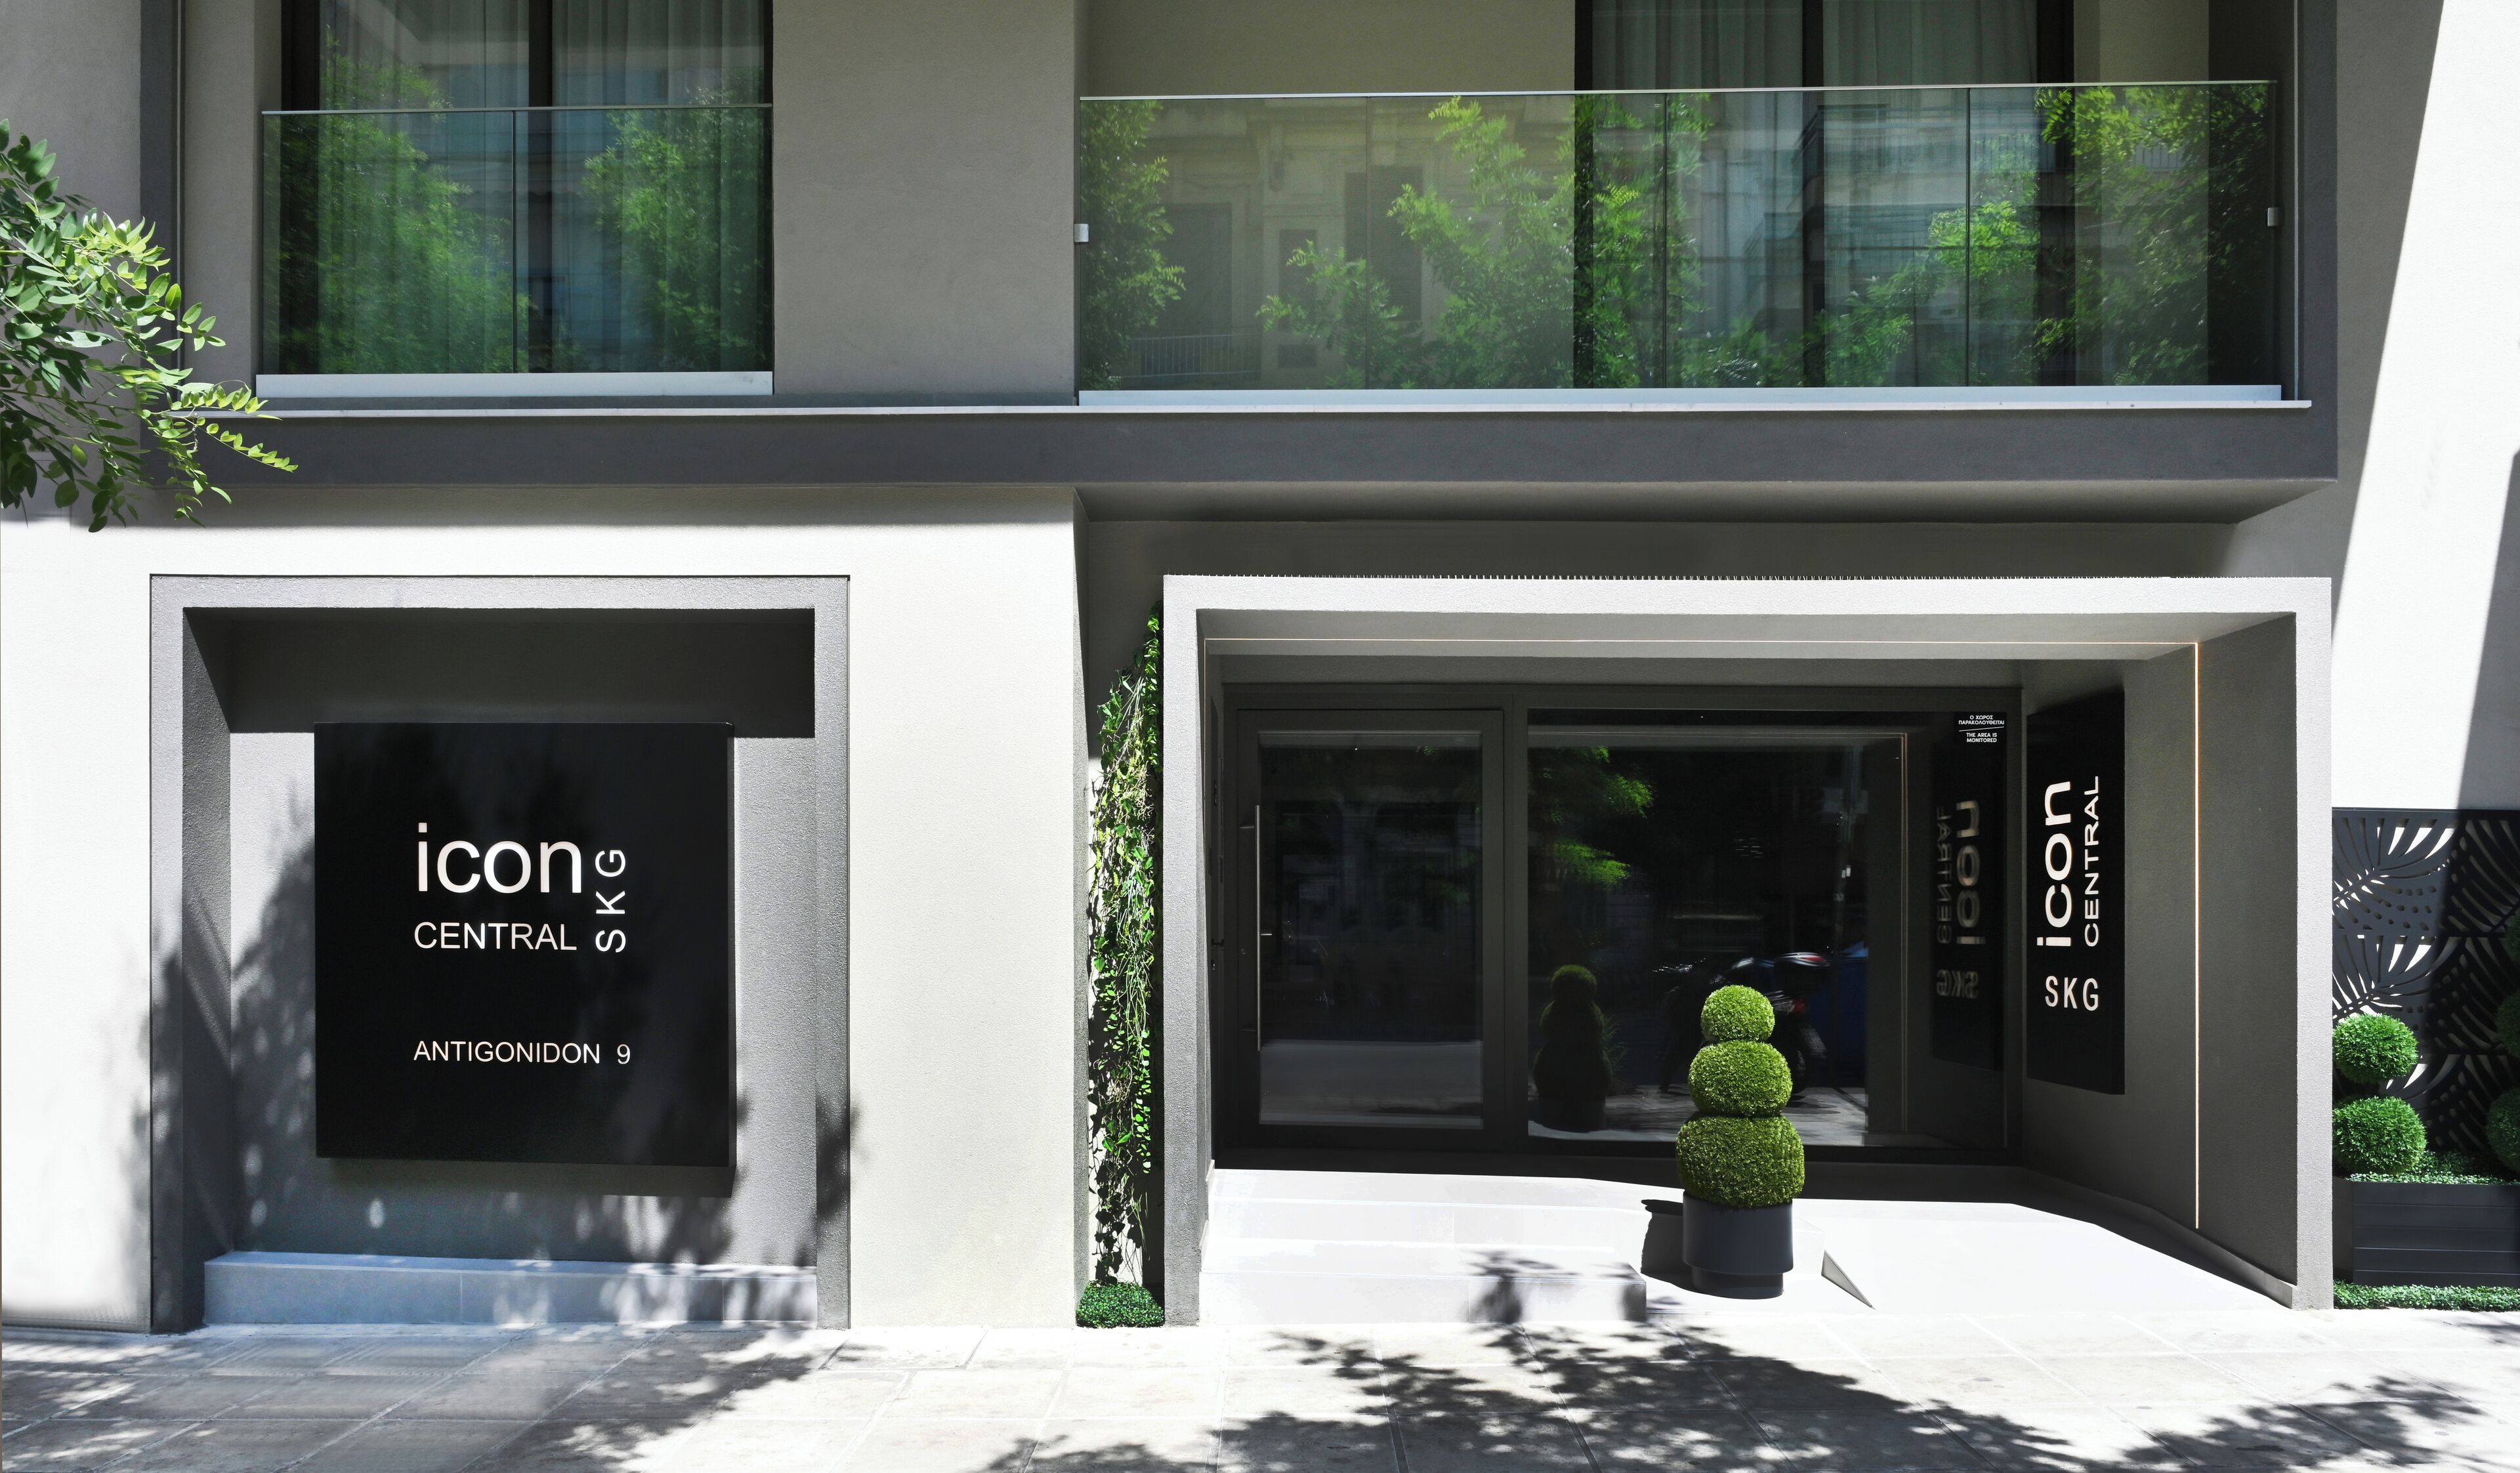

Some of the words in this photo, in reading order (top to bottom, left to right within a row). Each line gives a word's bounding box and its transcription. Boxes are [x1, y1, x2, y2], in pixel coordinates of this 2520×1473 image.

[417, 822, 583, 894] icon
[2036, 781, 2072, 947] icon
[2084, 776, 2099, 947] CENTRAL
[414, 921, 578, 951] CENTRAL
[595, 848, 627, 953] SKG
[2045, 975, 2099, 1011] SKG
[413, 1040, 600, 1064] ANTIGONIDON
[617, 1043, 631, 1065] 9
